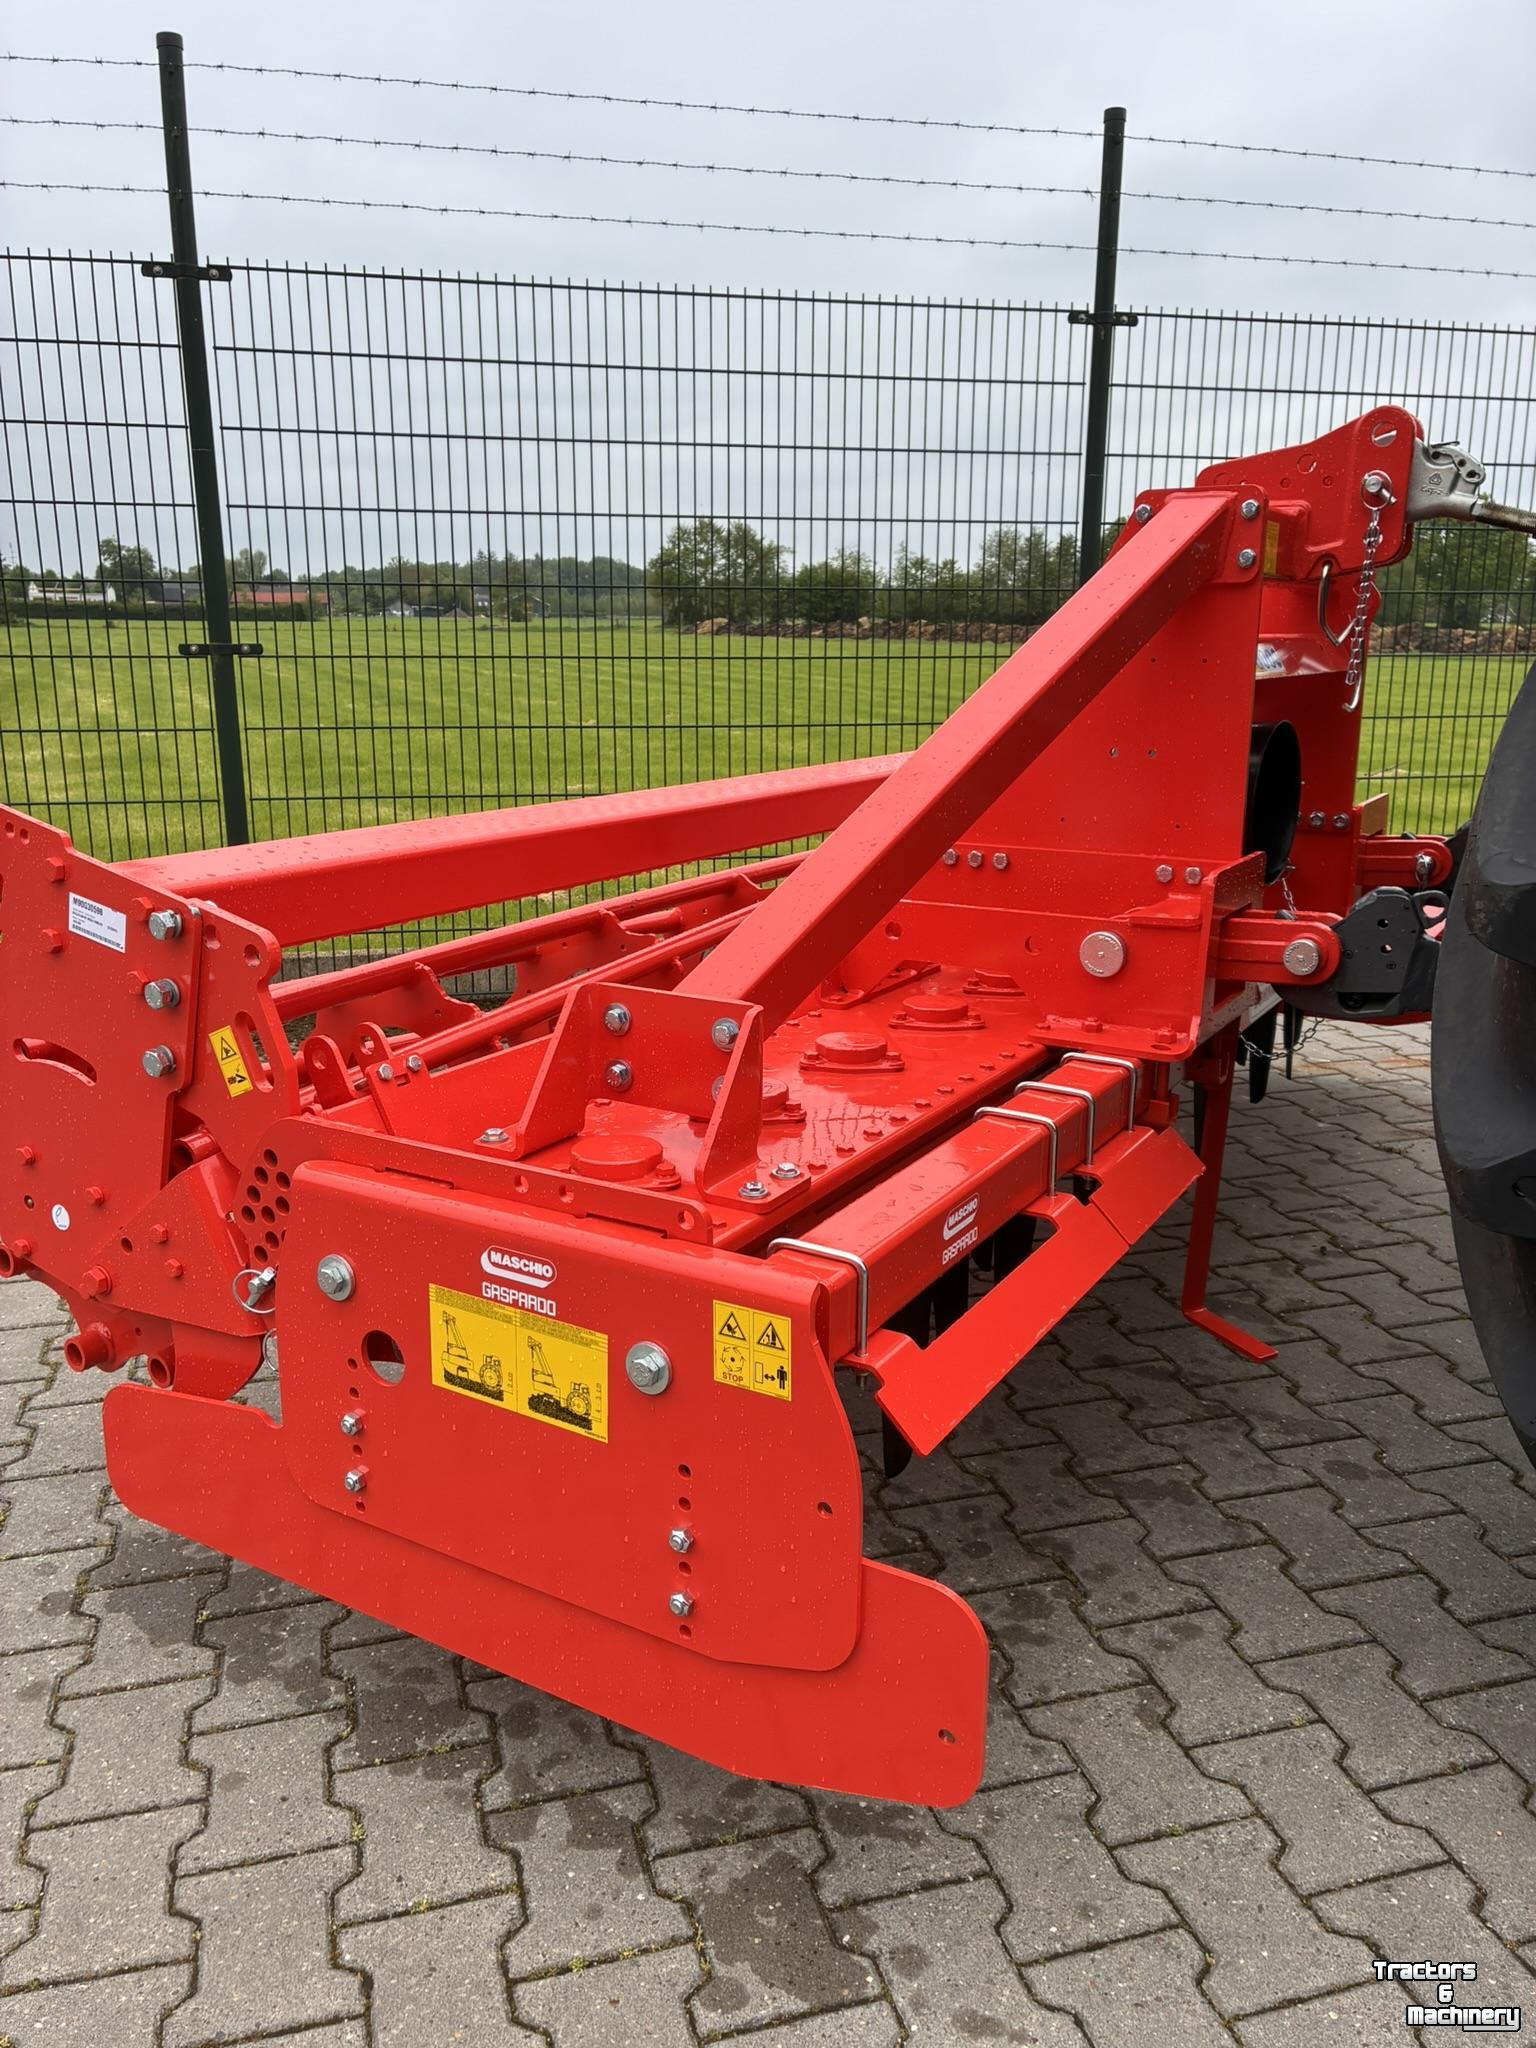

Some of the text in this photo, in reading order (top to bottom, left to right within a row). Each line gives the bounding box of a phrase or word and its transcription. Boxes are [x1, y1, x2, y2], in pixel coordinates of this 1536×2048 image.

[948, 1198, 978, 1228] MASCHIO
[942, 1226, 978, 1265] GASPARDO
[490, 1250, 553, 1278] MASCHIO
[482, 1281, 557, 1317] GASPARDO
[722, 1371, 744, 1383] STOP
